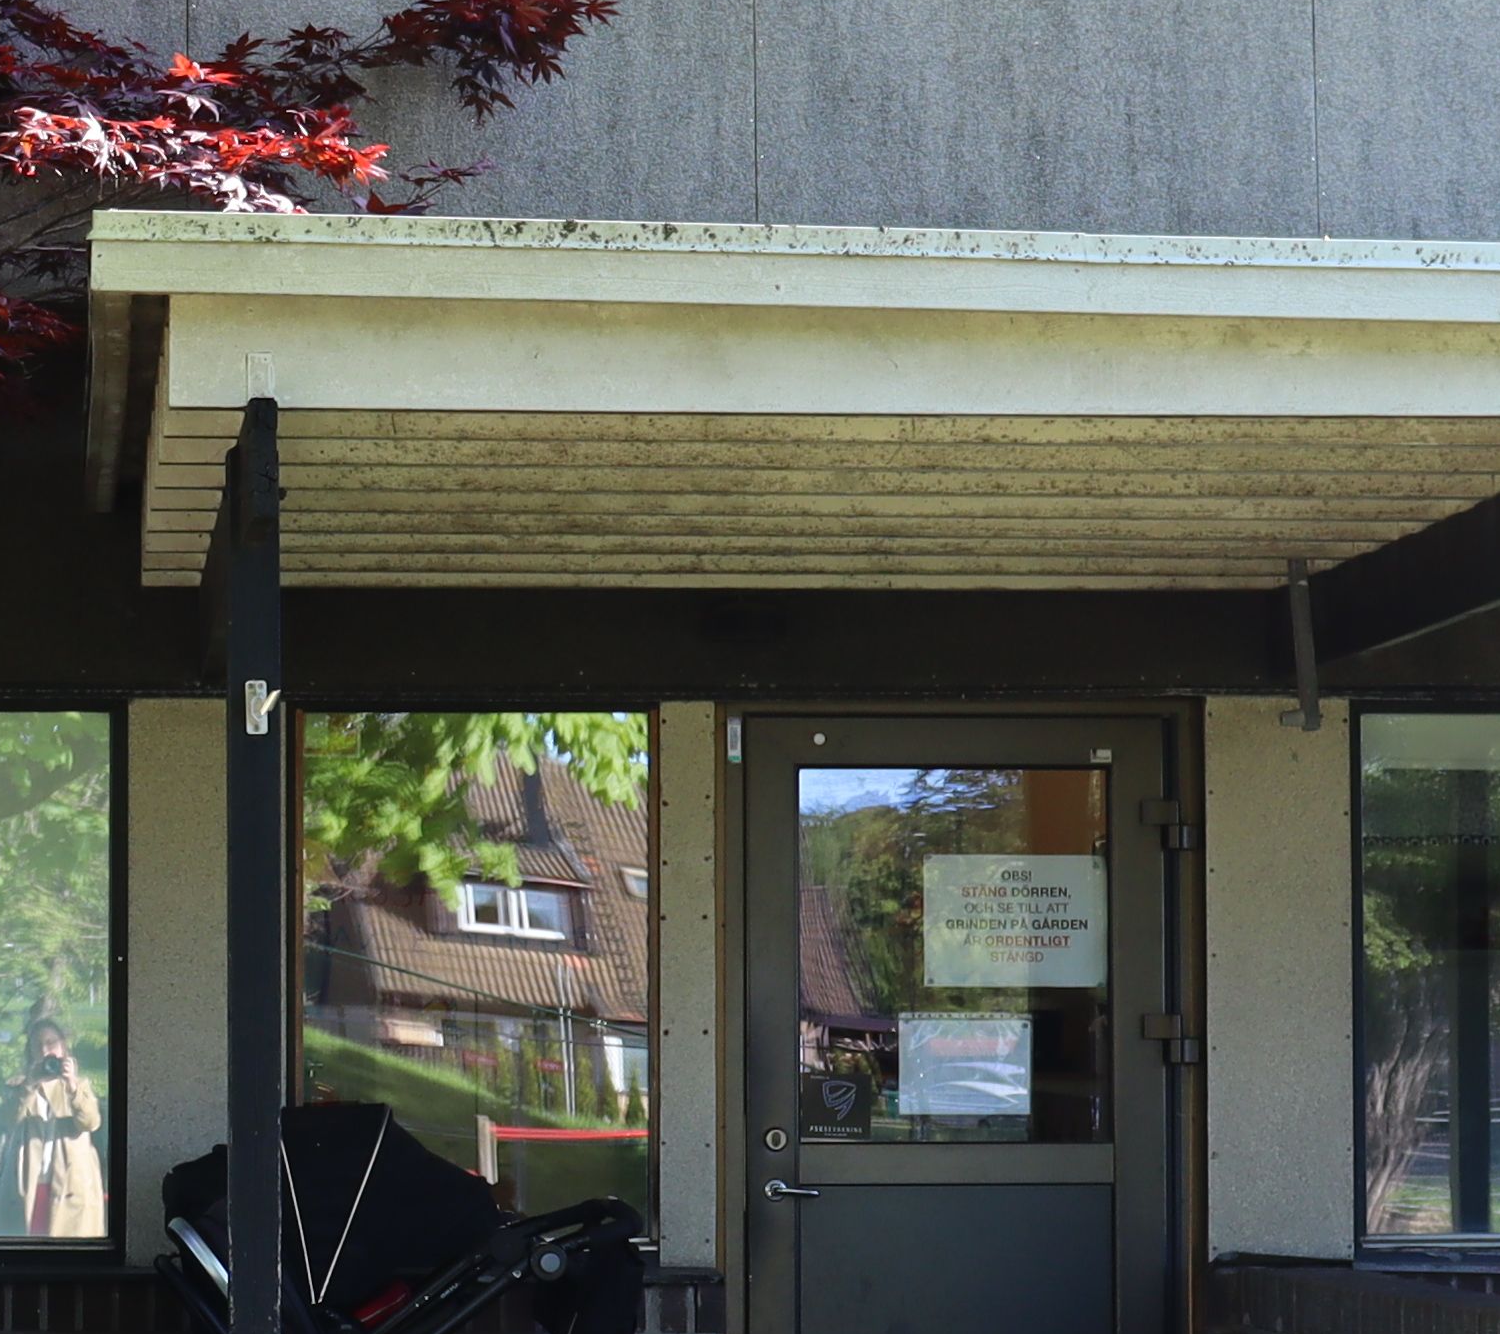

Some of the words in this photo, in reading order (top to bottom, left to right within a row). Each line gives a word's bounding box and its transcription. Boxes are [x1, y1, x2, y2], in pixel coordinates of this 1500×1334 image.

[962, 884, 1006, 897] STÄNG
[1012, 884, 1072, 899] DÖRREN,
[964, 903, 993, 913] OCH
[997, 903, 1013, 913] SE
[1017, 903, 1042, 913] TILL
[1046, 903, 1068, 913] ATT
[946, 919, 1006, 930] GRINDEN
[1010, 917, 1027, 930] PÅ
[1032, 917, 1088, 930] GÅRDEN
[985, 936, 1070, 946] ORDENTLIGT
